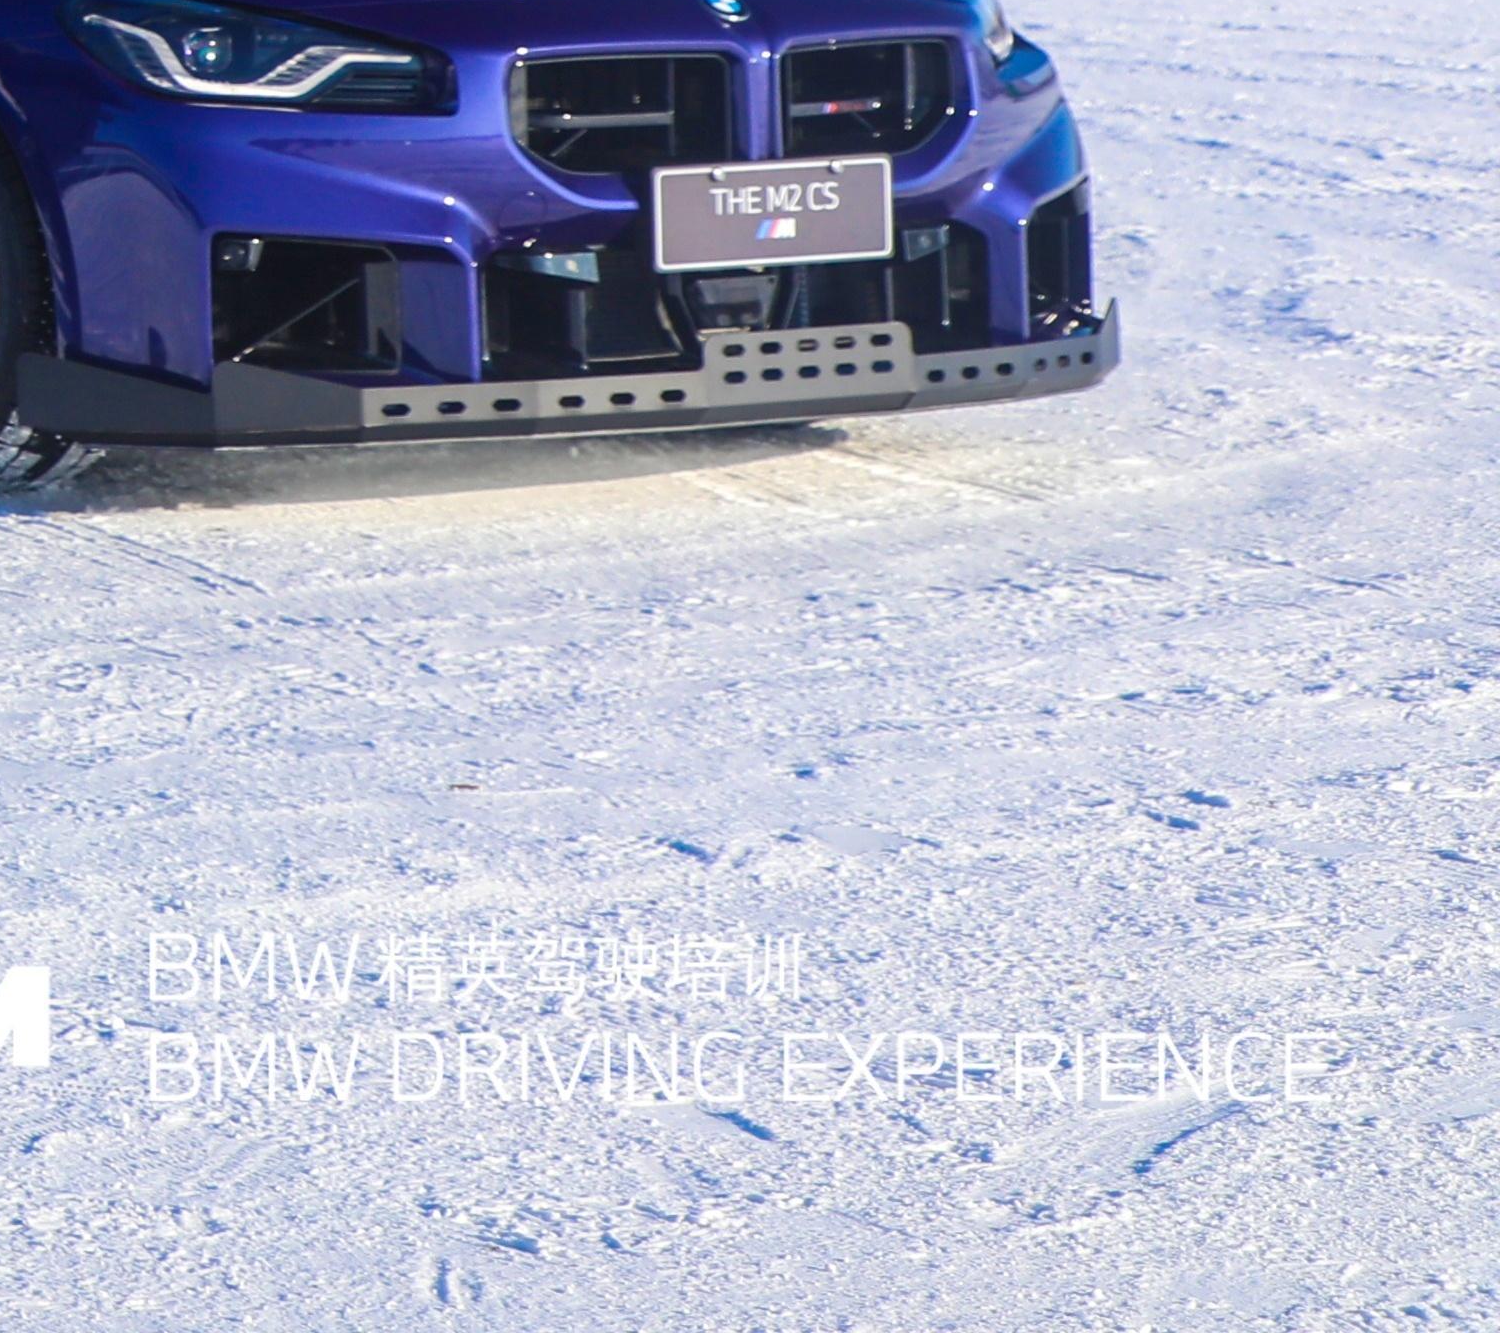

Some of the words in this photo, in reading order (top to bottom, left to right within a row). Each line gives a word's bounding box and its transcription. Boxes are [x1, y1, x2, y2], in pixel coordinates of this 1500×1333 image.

[709, 185, 763, 215] THE
[765, 183, 803, 213] M2
[806, 181, 840, 211] CS
